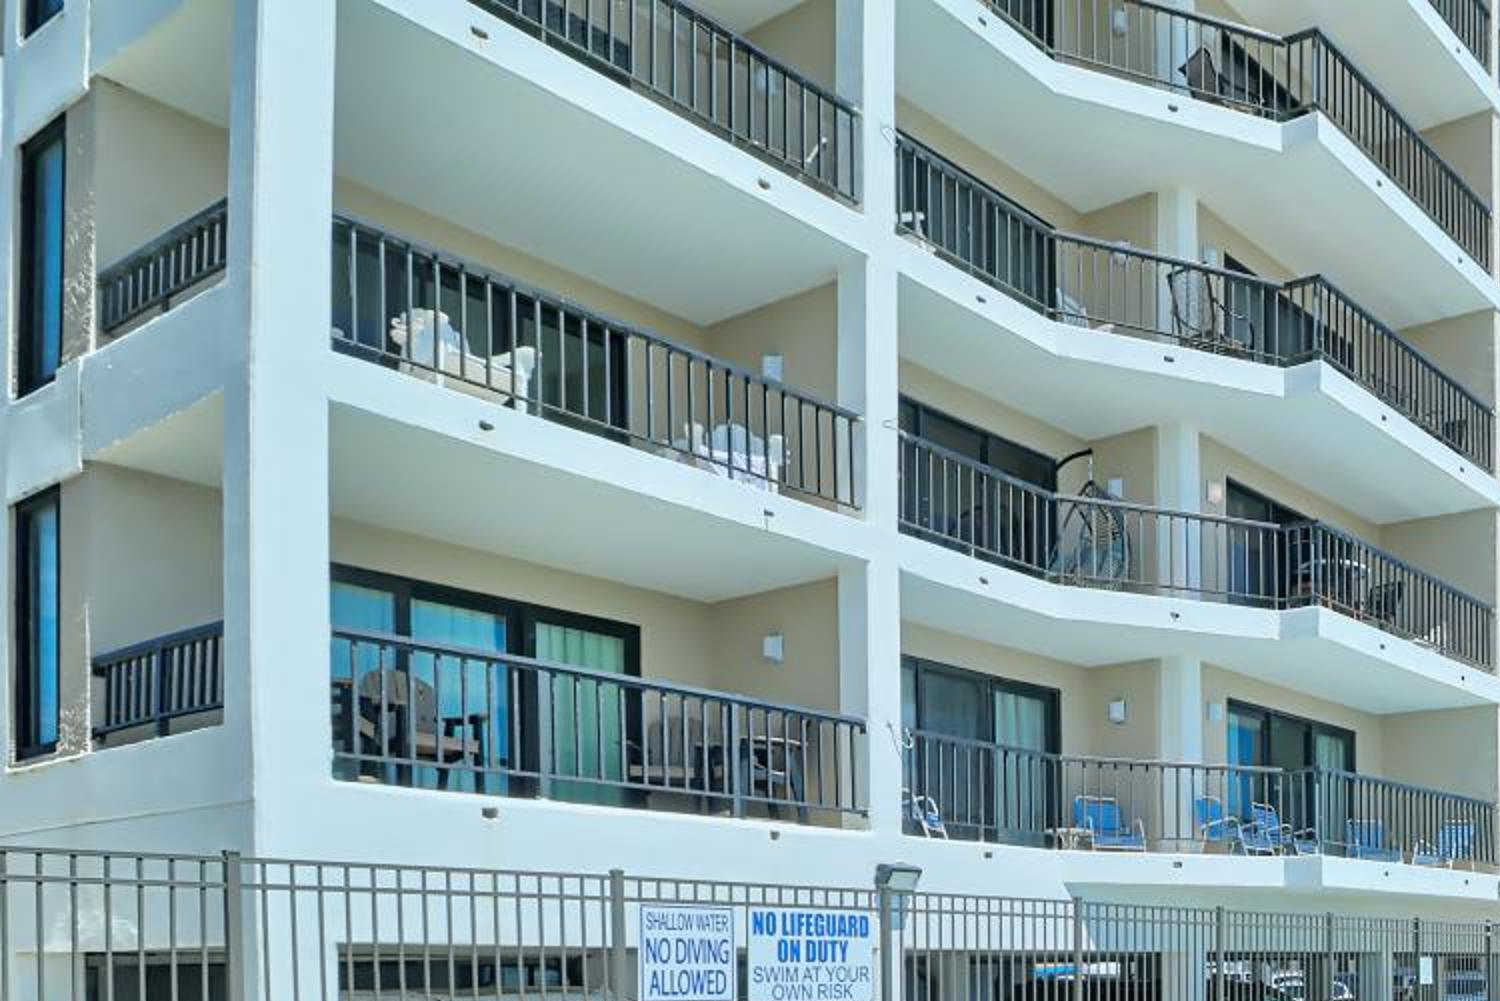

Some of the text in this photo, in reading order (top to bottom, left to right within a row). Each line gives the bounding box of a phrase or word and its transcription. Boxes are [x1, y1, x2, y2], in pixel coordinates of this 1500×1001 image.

[646, 912, 729, 932] SHALLOW WATER
[753, 911, 869, 938] NO LIFEGUARD
[646, 938, 729, 965] NO DIVING
[777, 939, 848, 962] ON DUTY
[649, 969, 727, 996] ALLOWED
[752, 966, 870, 983] SWIM AT YOUR
[771, 984, 853, 1001] OWN RISK
